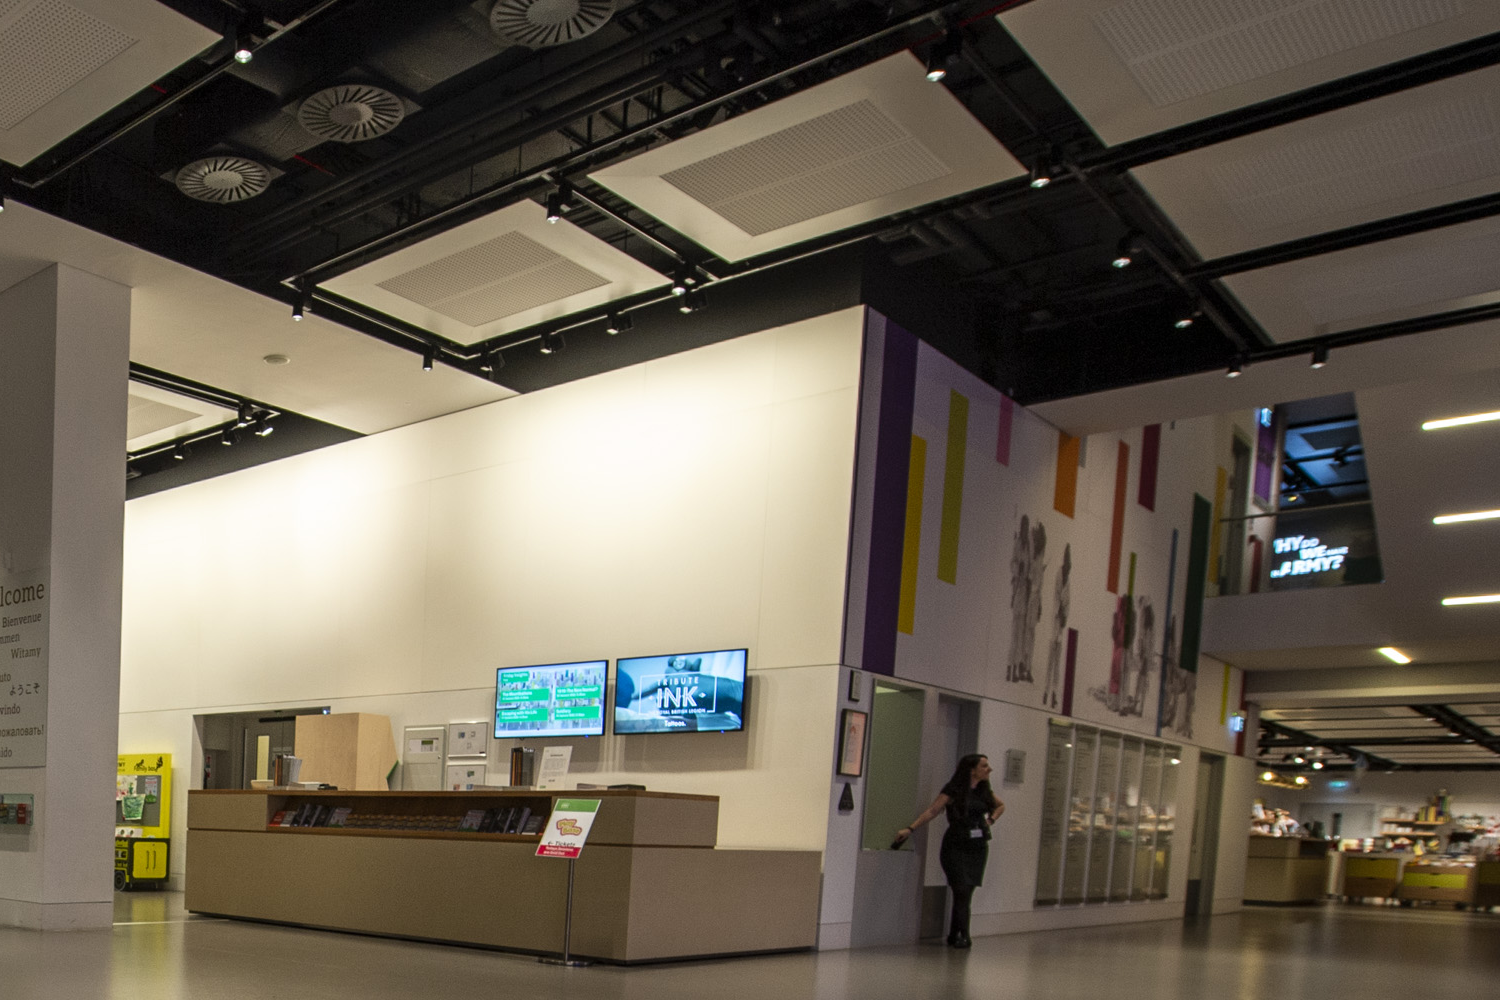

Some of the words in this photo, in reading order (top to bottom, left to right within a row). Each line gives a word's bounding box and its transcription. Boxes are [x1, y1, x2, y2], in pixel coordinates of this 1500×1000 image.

[2, 613, 42, 628] Bienvenue
[11, 647, 41, 659] Witamy
[657, 676, 699, 686] TRIBUTE
[10, 683, 40, 696] ようこそ
[656, 686, 699, 708] INK
